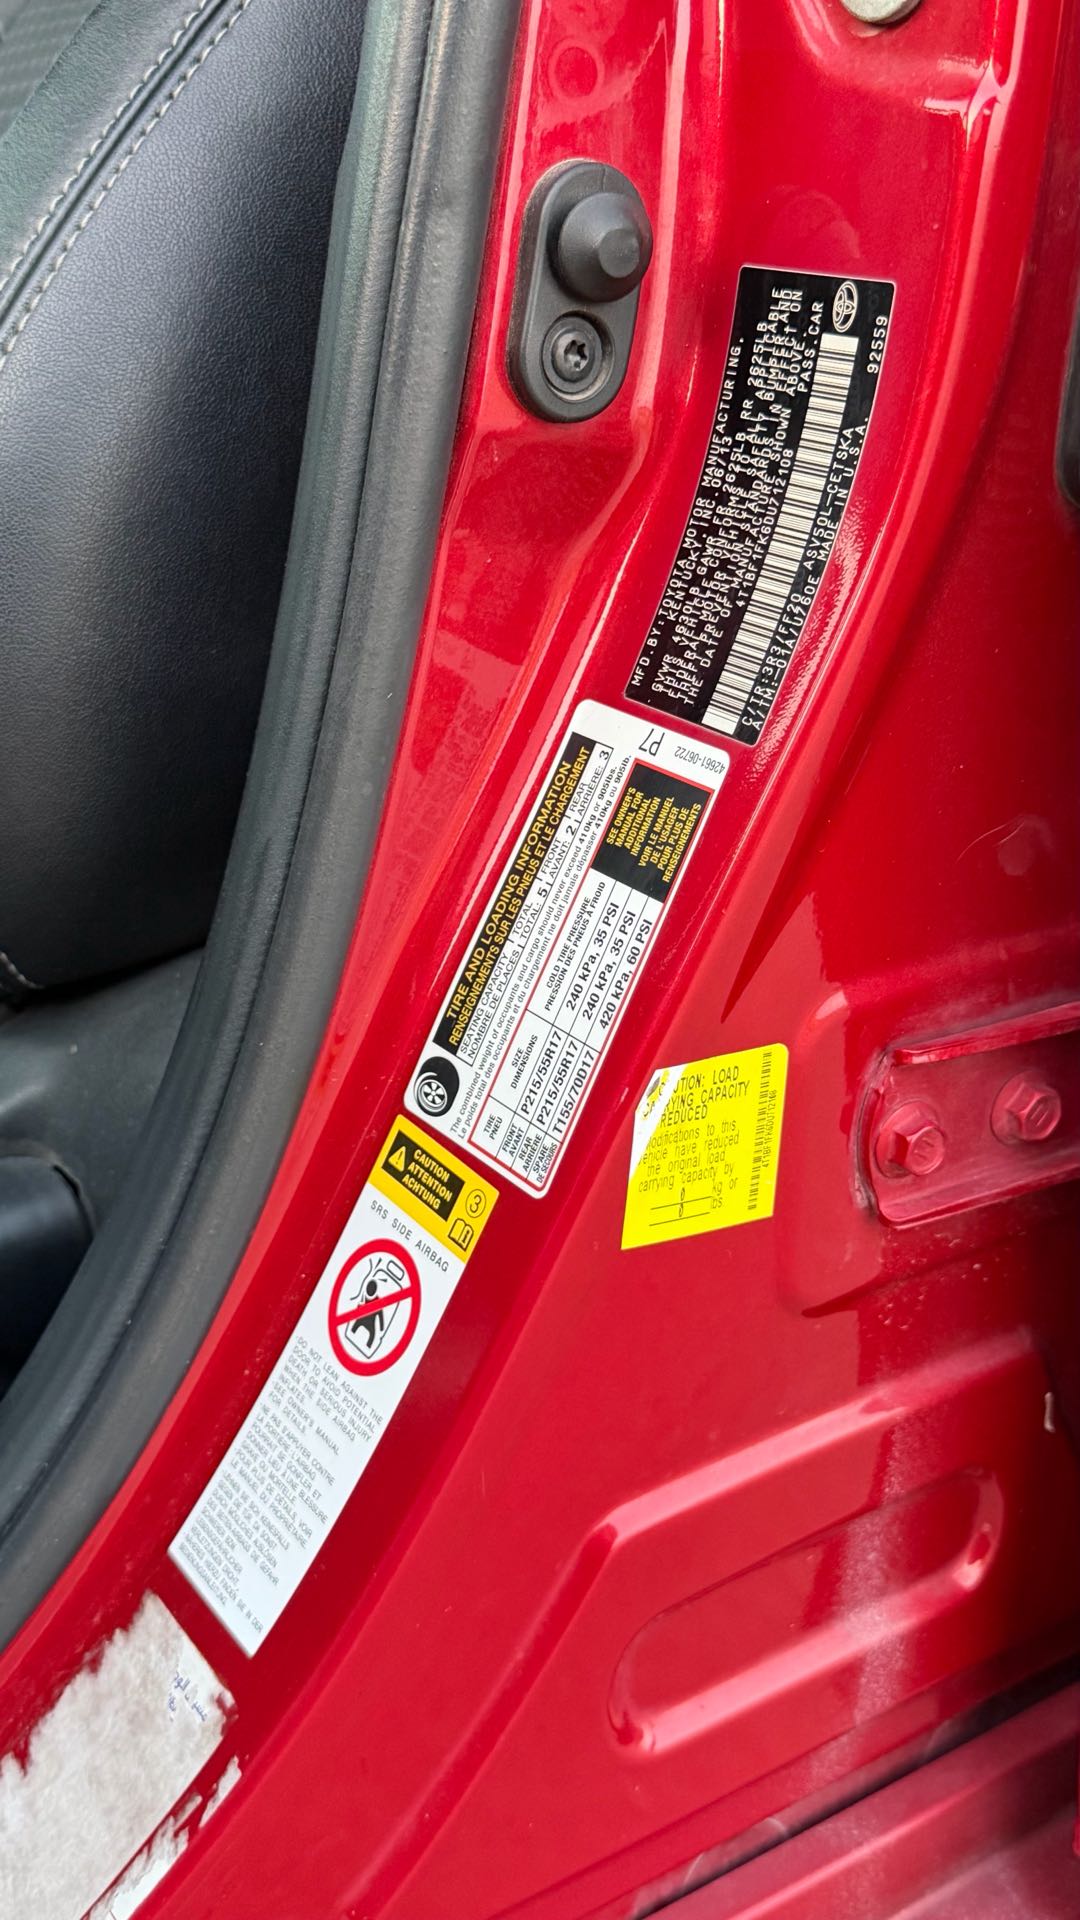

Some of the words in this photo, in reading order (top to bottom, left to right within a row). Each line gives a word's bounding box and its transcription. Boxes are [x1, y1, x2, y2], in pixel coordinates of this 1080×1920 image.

[867, 316, 888, 373] 92559
[651, 654, 673, 692] GVWR
[672, 586, 700, 644] 4630LB
[696, 536, 718, 575] GAWR
[712, 504, 727, 525] FR
[722, 432, 747, 493] 2625LB
[740, 400, 754, 420] RR
[747, 322, 768, 386] 2625LB
[740, 437, 774, 531] STANDARDS
[682, 497, 706, 548] MOTOR
[736, 448, 794, 607] 4T1BF1FK6DU712108
[817, 520, 839, 561] MADE
[834, 488, 848, 506] IN
[679, 578, 713, 646] VEHICLE
[708, 486, 742, 567] CONFORMS
[684, 676, 703, 704] THE
[700, 628, 723, 668] DATE
[730, 474, 775, 588] MANUFACTURE
[770, 408, 791, 462] SHOWN
[699, 571, 726, 621] MOTOR
[638, 728, 665, 756] P7
[674, 746, 725, 774] 42661-06722
[606, 827, 618, 844] SEE
[614, 787, 636, 826] OWNER'S
[614, 812, 636, 847] MANUAL
[631, 792, 644, 809] FOR
[624, 798, 651, 849] ADDITIONAL
[630, 797, 661, 856] INFORMATION
[638, 846, 653, 866] VOIR
[648, 833, 658, 845] LE
[653, 797, 674, 832] MANUEL
[650, 850, 660, 863] DE
[656, 807, 679, 850] L'USAGER
[657, 846, 673, 870] POUR
[668, 822, 683, 844] PLUS
[678, 808, 689, 820] DE
[662, 803, 701, 882] RENSEIGNEMENTS
[446, 983, 469, 1018] TIRE
[465, 947, 485, 982] AND
[480, 874, 520, 944] LOADING
[515, 761, 571, 870] INFORMATION
[449, 945, 500, 1045] RENSEIGNEMENTS
[494, 920, 511, 944] SUR
[505, 897, 522, 919] LES
[516, 858, 540, 896] PNEUS
[534, 841, 546, 858] ET
[541, 825, 555, 841] LE
[549, 746, 589, 825] CHARGEMENT
[460, 1008, 484, 1054] SEATING
[481, 952, 508, 1006] CAPACITY
[512, 903, 532, 934] TOTAL
[540, 837, 561, 874] FRONT
[569, 782, 587, 812] REAR
[467, 1010, 492, 1059] NOMBRE
[488, 993, 500, 1010] DE
[496, 950, 520, 992] PLACES
[519, 902, 541, 938] TOTAL:
[536, 887, 548, 898] 5
[549, 840, 570, 878] AVANT:
[565, 824, 576, 836] 2
[598, 749, 609, 760] 3
[459, 1071, 481, 1115] combined
[477, 1040, 495, 1071] weight
[496, 983, 520, 1028] occupants
[516, 963, 528, 982] and
[526, 938, 540, 963] cargo
[538, 906, 554, 936] should
[552, 880, 566, 904] never
[564, 846, 581, 878] exceed
[578, 814, 596, 844] 410kg
[598, 767, 617, 800] 905lbs.
[463, 1101, 479, 1126] poids
[474, 1079, 487, 1100] total
[483, 1061, 495, 1078] des
[492, 1015, 515, 1061] occupants
[523, 936, 550, 989] chargement
[554, 904, 565, 922] doit
[561, 873, 578, 904] jamais
[576, 830, 597, 872] dépasser
[595, 800, 612, 829] 410kg
[614, 756, 631, 784] 905lb.
[544, 967, 568, 1011] PRESSION
[564, 948, 576, 966] DES
[572, 918, 589, 947] PNEUS
[590, 882, 605, 908] FROID
[546, 965, 560, 988] COLD
[557, 943, 570, 962] TIRE
[566, 897, 590, 942] PRESSURE
[566, 984, 583, 1011] 240
[578, 952, 600, 982] kPa,
[593, 928, 607, 948] 35
[602, 902, 619, 926] PSI
[582, 992, 600, 1020] 240
[594, 961, 616, 991] kPa,
[610, 937, 624, 956] 35
[618, 910, 636, 935] PSI
[598, 1001, 616, 1029] 420
[611, 970, 633, 1000] kPa,
[626, 946, 641, 965] 60
[635, 919, 652, 944] PSI
[510, 1034, 538, 1089] DIMENSIONS
[512, 1048, 523, 1068] SIZE
[520, 1030, 561, 1114] P215/55R17
[536, 1040, 578, 1125] P215/55R17
[712, 1066, 739, 1085] LOAD
[552, 1050, 594, 1134] T155/70D17
[660, 1105, 708, 1128] REDUCED
[701, 1080, 750, 1103] CAPACITY
[484, 1114, 495, 1132] TIRE
[489, 1116, 502, 1140] PNEU
[502, 1123, 517, 1152] FRONT
[508, 1127, 524, 1157] AVANT
[518, 1136, 532, 1160] REAR
[707, 1124, 715, 1136] to
[721, 1120, 735, 1133] this
[408, 1162, 452, 1202] ATTENTION
[414, 1149, 450, 1182] CAUTION
[533, 1144, 549, 1173] SPARE
[540, 1142, 557, 1173] SECOURS
[402, 1174, 440, 1209] ACHTUNG
[468, 1193, 483, 1214] 3
[370, 1200, 388, 1219] SRS
[392, 1218, 412, 1240] SIDE
[415, 1240, 449, 1272] AIRBAG
[288, 1354, 307, 1376] DEATH
[320, 1387, 346, 1418] SERIOUS
[348, 1416, 372, 1442] INJURY
[292, 1345, 311, 1366] DOOR
[322, 1376, 340, 1396] AVOID
[342, 1395, 374, 1434] POTENTIAL
[309, 1348, 322, 1362] NOT
[323, 1362, 338, 1381] LEAN
[340, 1381, 368, 1408] AGAINST
[370, 1408, 383, 1425] THE
[315, 1426, 339, 1455] MANUAL
[332, 1415, 356, 1442] AIRBAG
